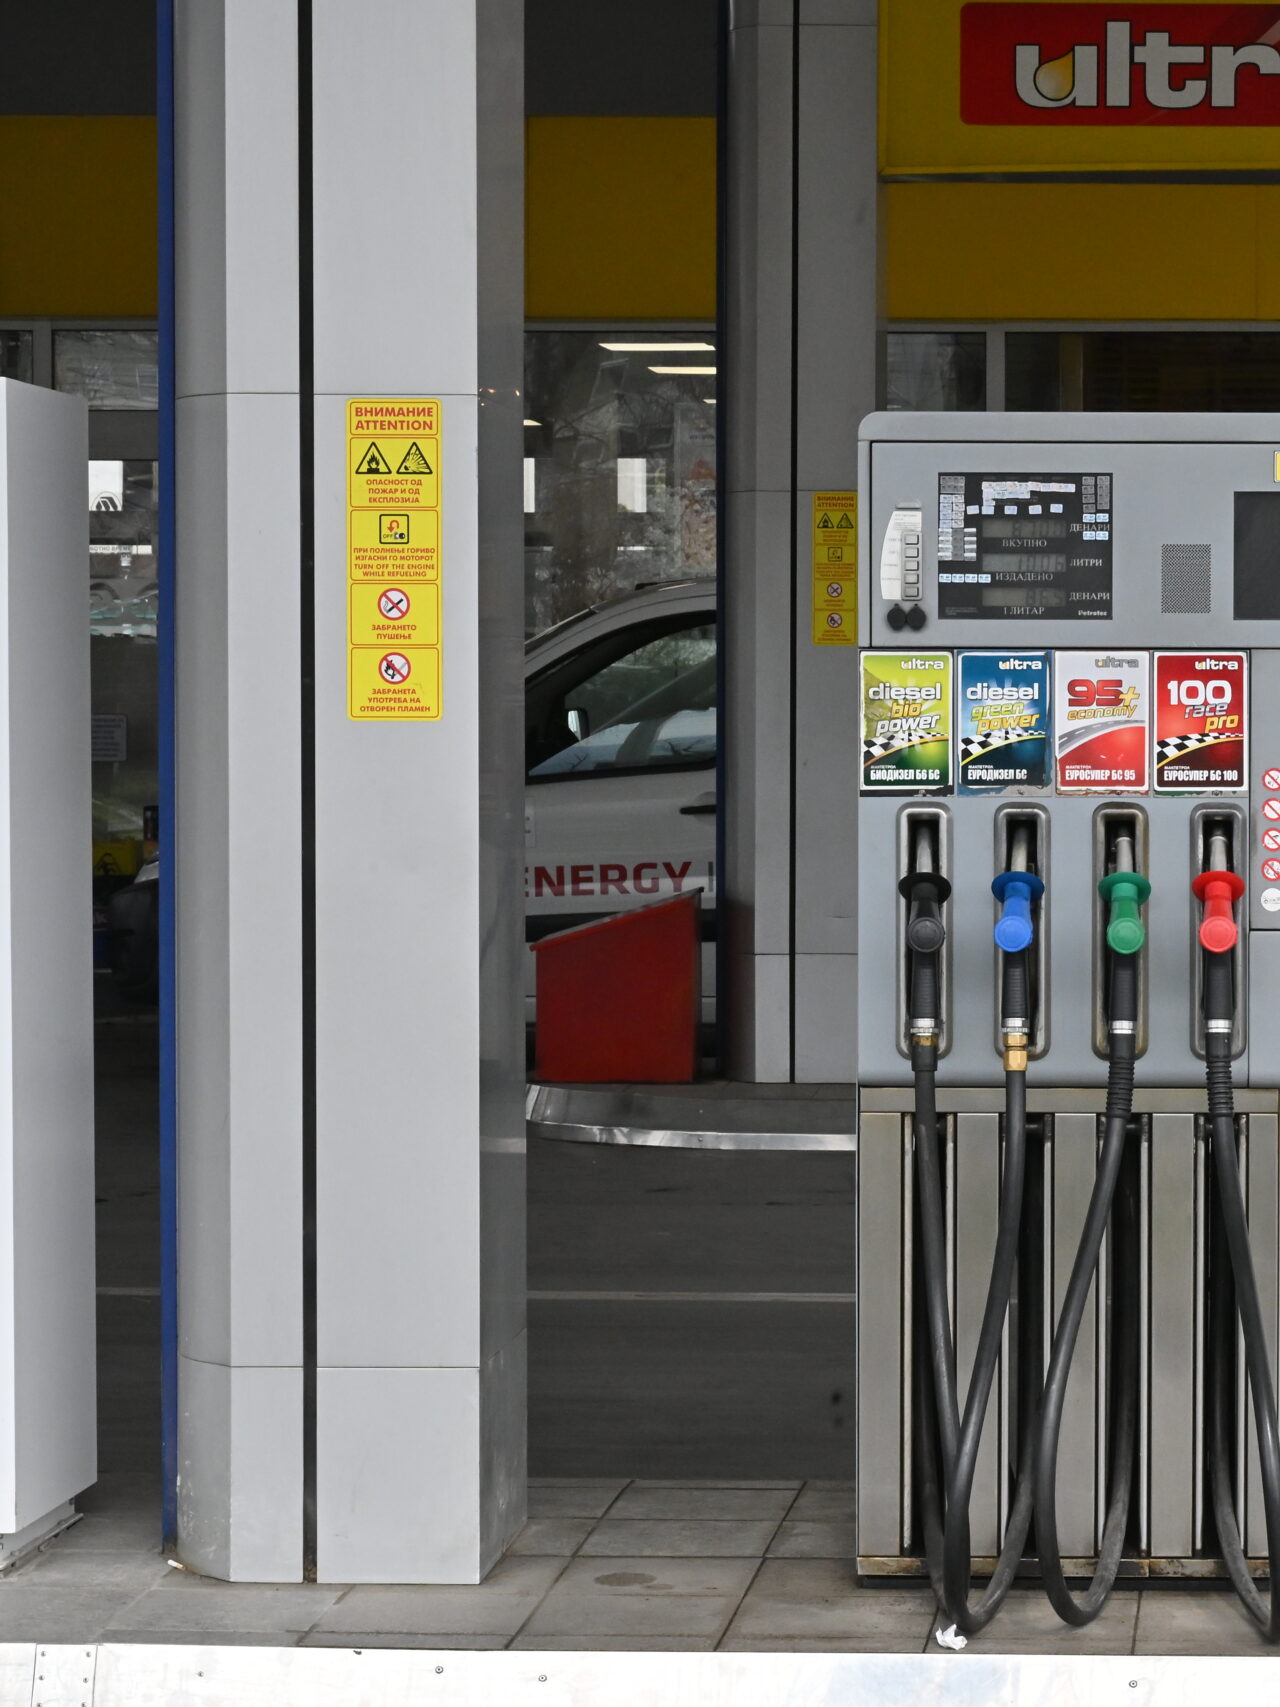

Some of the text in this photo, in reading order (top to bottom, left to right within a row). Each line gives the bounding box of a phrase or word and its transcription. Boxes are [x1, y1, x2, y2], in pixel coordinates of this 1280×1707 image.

[355, 407, 433, 417] ВНИМАНИЕ
[355, 420, 433, 430] ATTENTION
[1069, 524, 1110, 532] ДЕНАРИ
[1002, 539, 1047, 548] ВКУПНО
[1069, 558, 1103, 567] ЛИТРИ
[995, 573, 1053, 582] ИЗДАДЕНО
[1069, 592, 1110, 601] ДЕНАРИ
[1009, 607, 1045, 616] ЛИТАР
[901, 658, 944, 670] ultra
[999, 658, 1042, 670] ultra
[1094, 656, 1139, 669] ultra
[1195, 658, 1239, 670] ultra
[868, 682, 942, 700] diesel
[966, 682, 1039, 700] diesel
[1167, 680, 1232, 706] 100
[890, 702, 922, 718] bio
[970, 702, 1024, 722] green
[1067, 704, 1137, 721] economy
[1184, 703, 1229, 719] race
[875, 714, 940, 737] power
[976, 714, 1040, 736] power
[1204, 714, 1239, 734] pro
[870, 769, 914, 781] БИОДИЗЕЛ
[928, 769, 940, 780] БС
[967, 769, 1027, 781] ЕУРОДИЗЕЛ БС
[1065, 769, 1136, 781] ЕУРОСУПЕР БС 95
[1164, 770, 1238, 781] ЕУРОСУПЕР БС 100
[525, 861, 692, 898] NERGY
